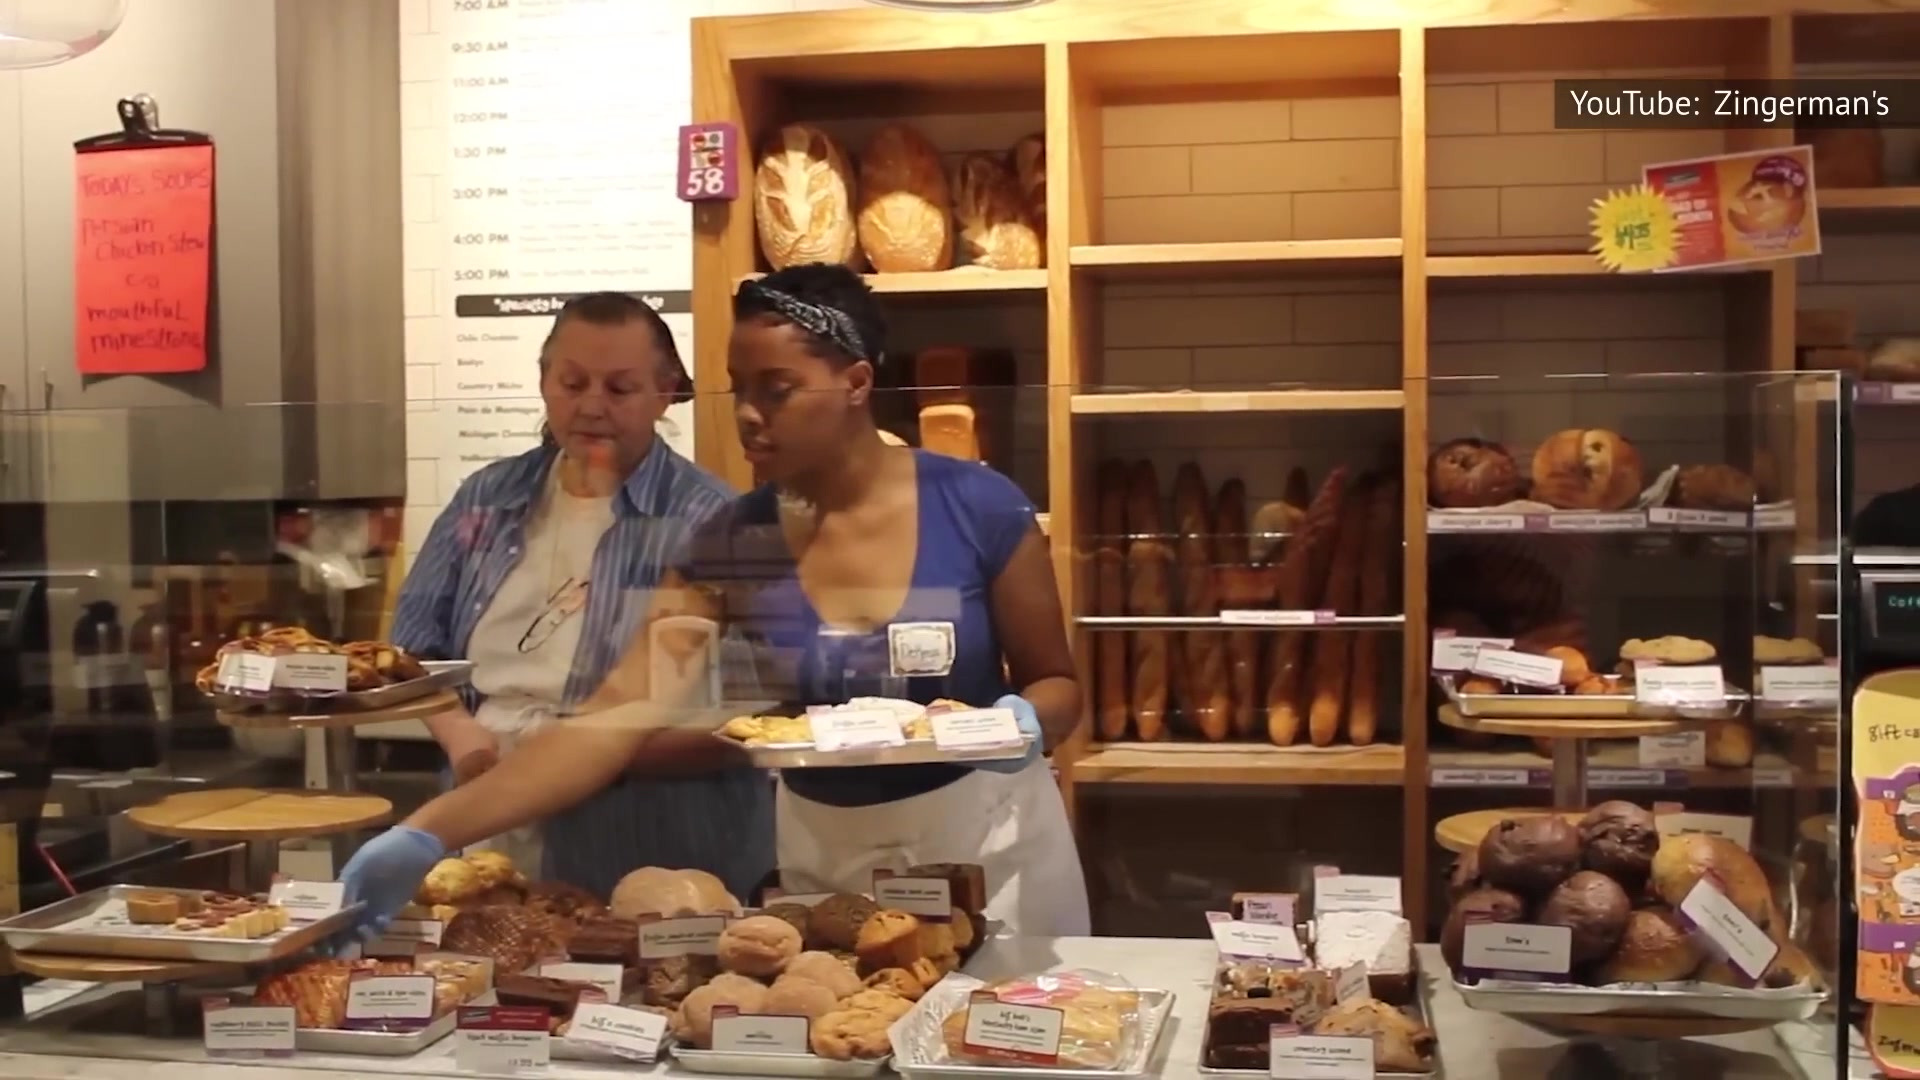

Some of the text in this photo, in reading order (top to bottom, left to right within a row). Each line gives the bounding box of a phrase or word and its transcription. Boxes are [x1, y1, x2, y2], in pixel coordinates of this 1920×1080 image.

[452, 42, 483, 53] 9:30
[687, 168, 725, 196] 58
[454, 233, 484, 244] 4:00
[455, 269, 484, 281] 5:00
[1868, 723, 1901, 743] gift
